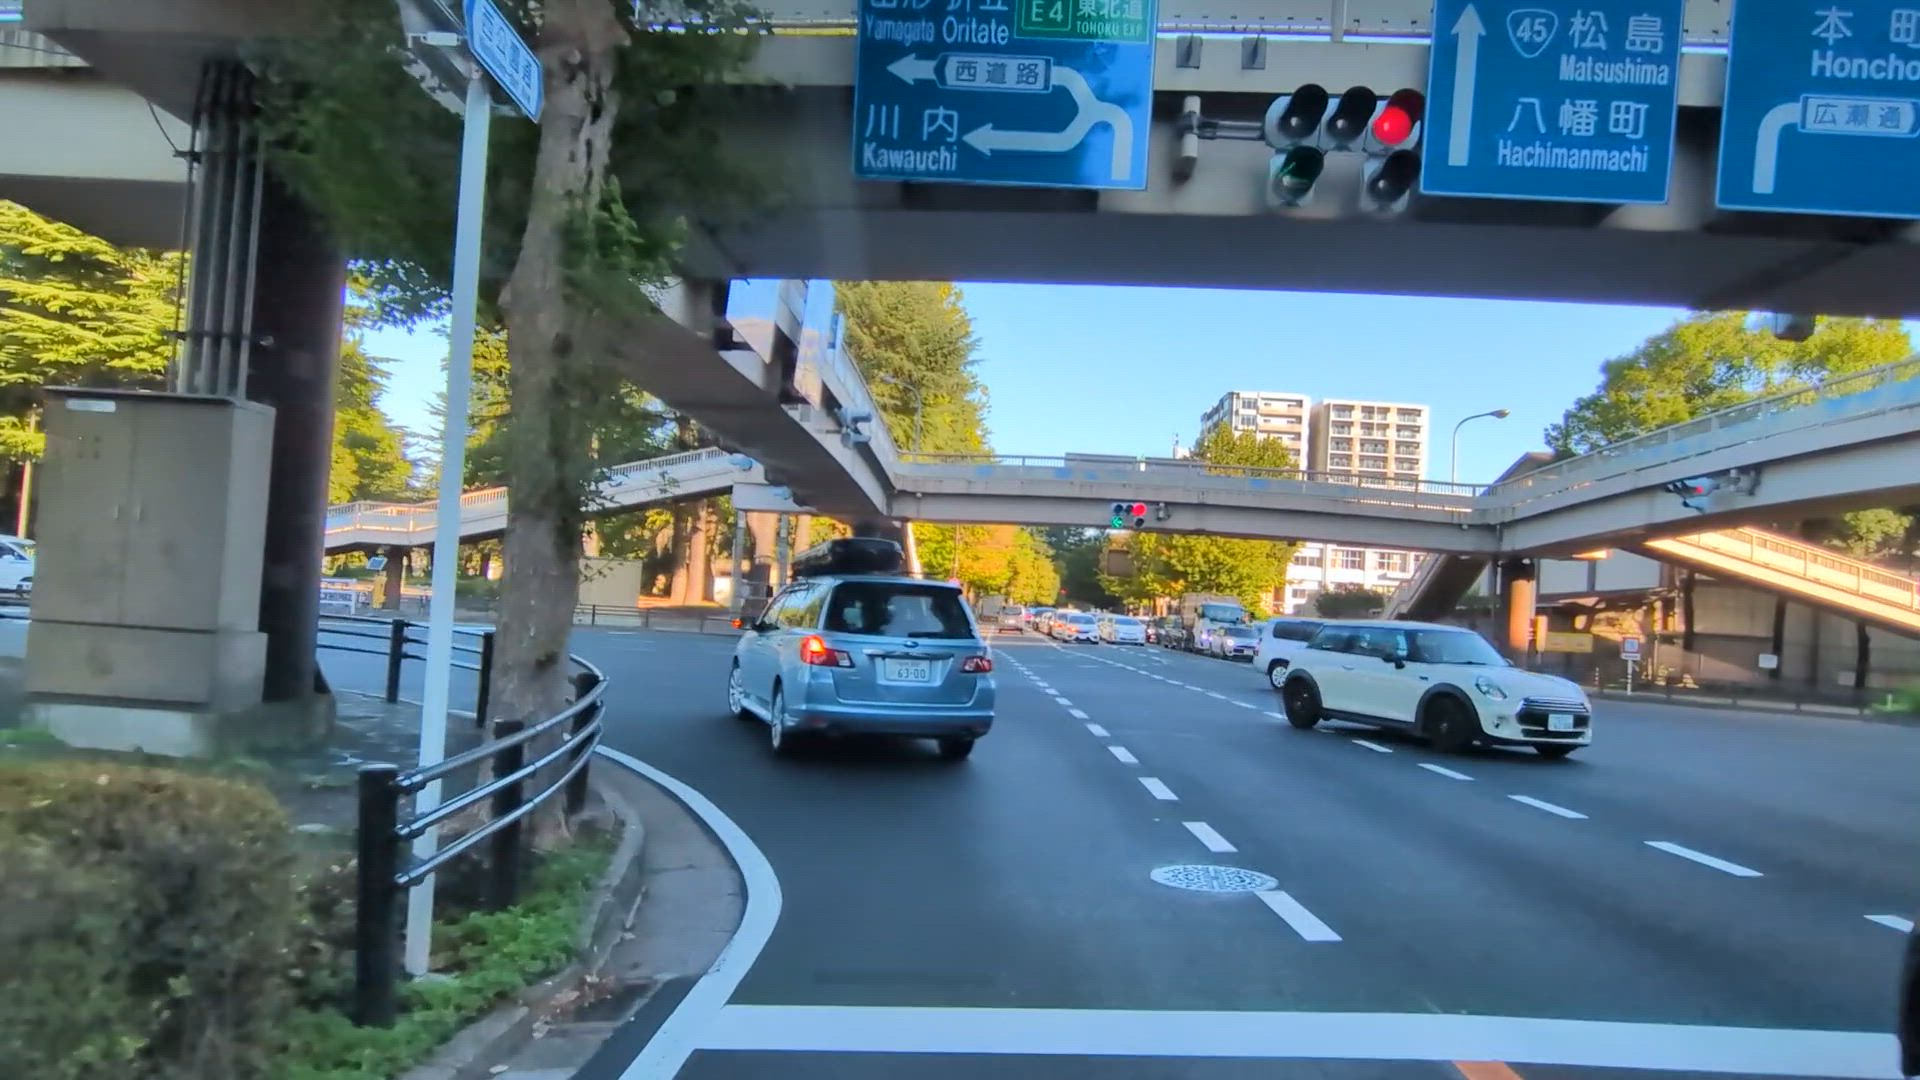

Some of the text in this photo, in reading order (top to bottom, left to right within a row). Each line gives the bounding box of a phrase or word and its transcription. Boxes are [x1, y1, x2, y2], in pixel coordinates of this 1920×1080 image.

[865, 14, 1009, 46] Yamagata Oritate
[1076, 21, 1120, 36] TOHOKU
[1516, 17, 1547, 43] 45
[1568, 9, 1664, 54] 松島
[1811, 5, 1920, 49] 本町
[955, 60, 1040, 85] 西道路
[1559, 54, 1669, 86] Matsushima
[1811, 49, 1920, 80] Honcho
[865, 104, 959, 142] 川内
[1507, 97, 1649, 139] 八幡町
[1813, 103, 1900, 129] 広瀬通
[863, 142, 958, 171] Kawauchi
[1497, 139, 1649, 172] Hachimanmachi
